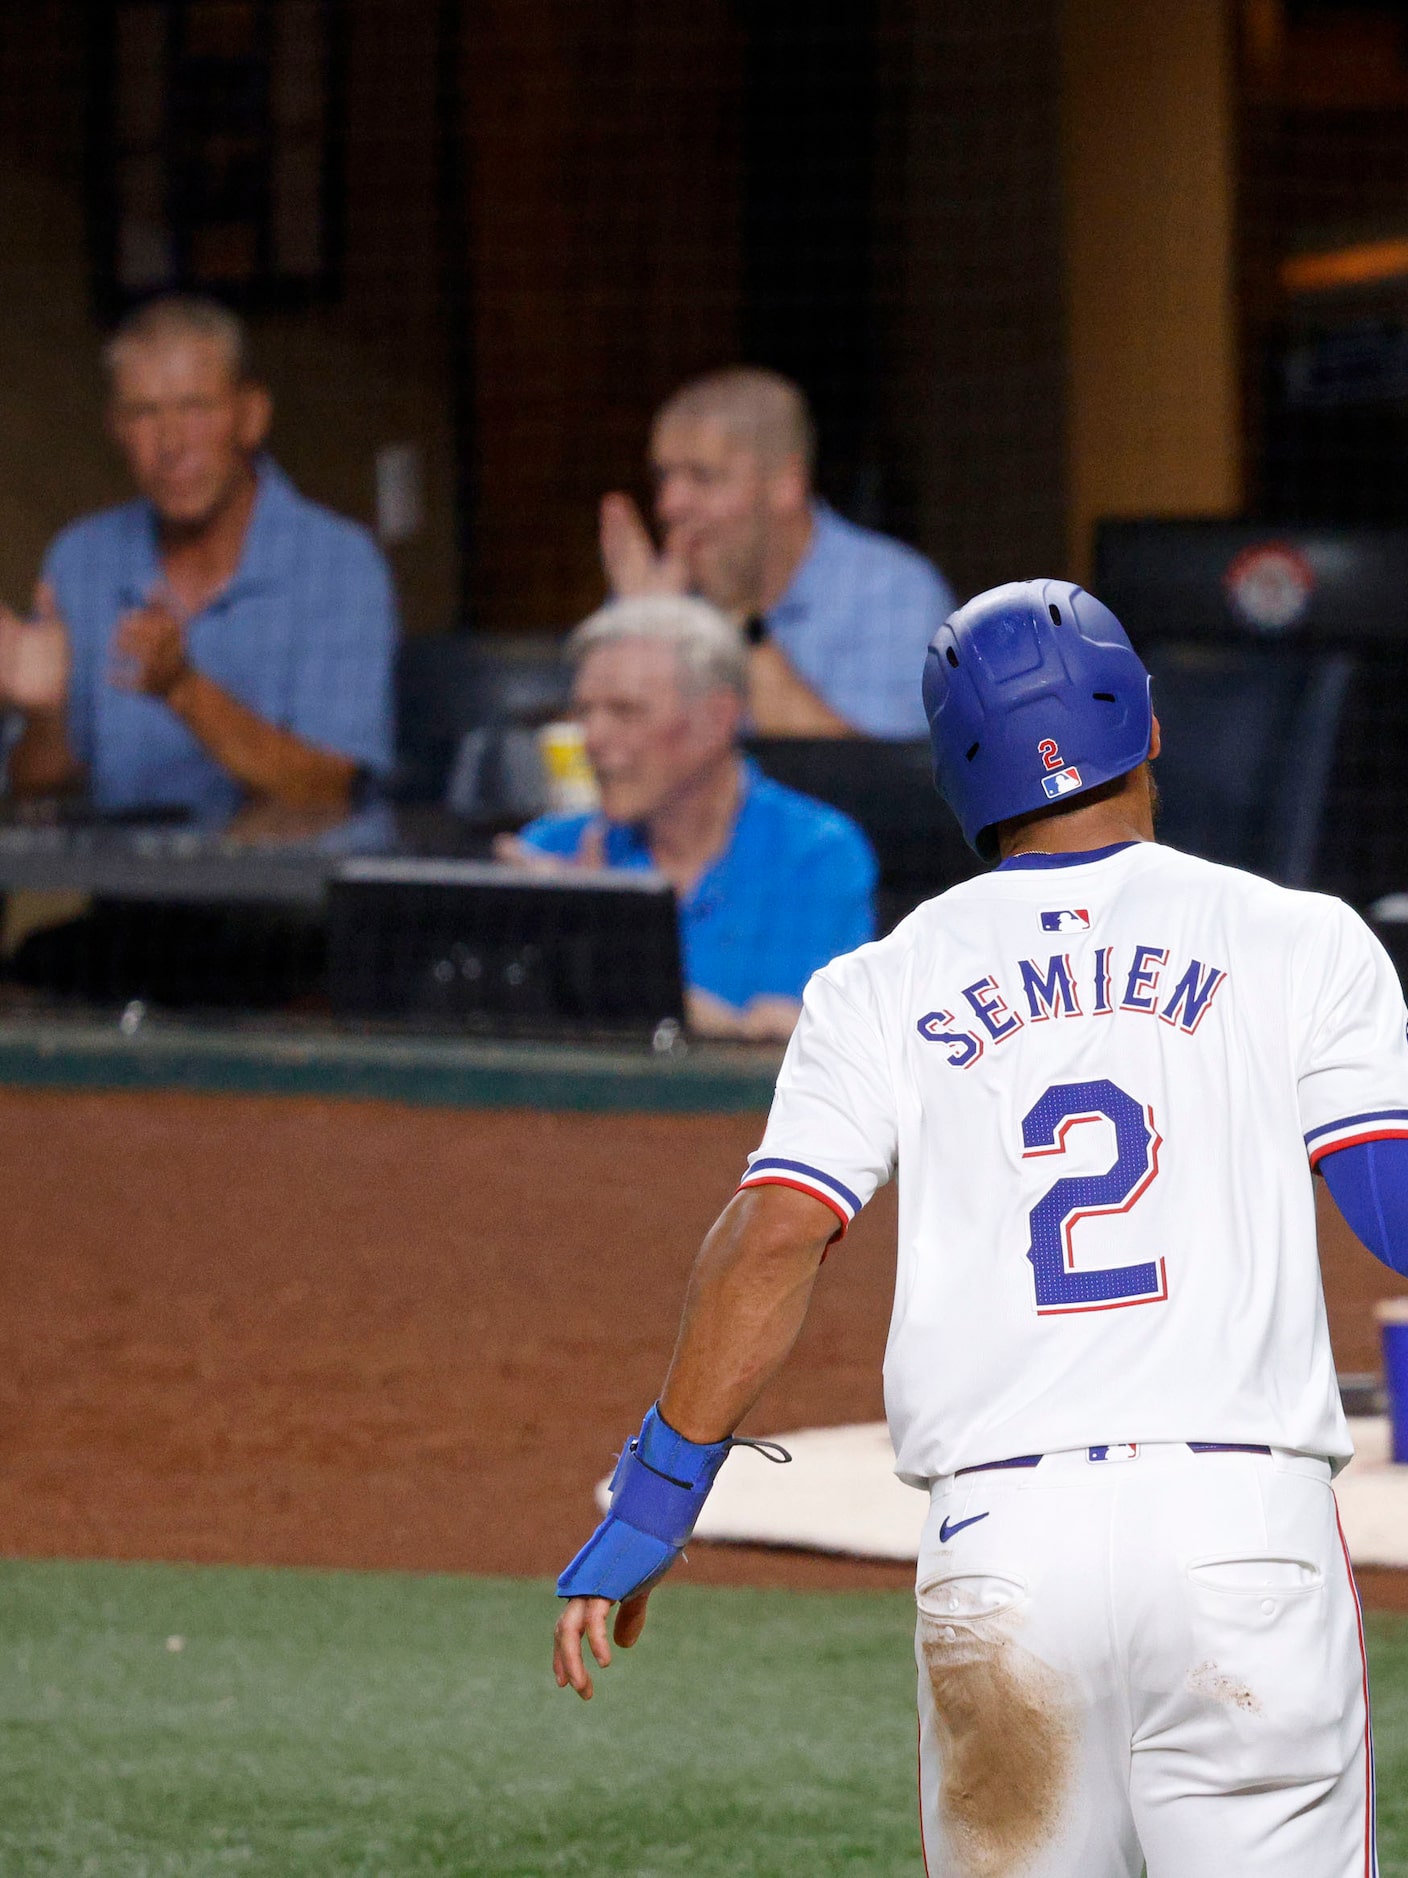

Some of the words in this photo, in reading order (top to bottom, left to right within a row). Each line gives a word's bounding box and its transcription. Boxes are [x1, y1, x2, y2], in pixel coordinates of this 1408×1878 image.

[1038, 738, 1065, 771] 2
[916, 945, 1228, 1070] SEMIEN
[1021, 1078, 1169, 1317] 2
